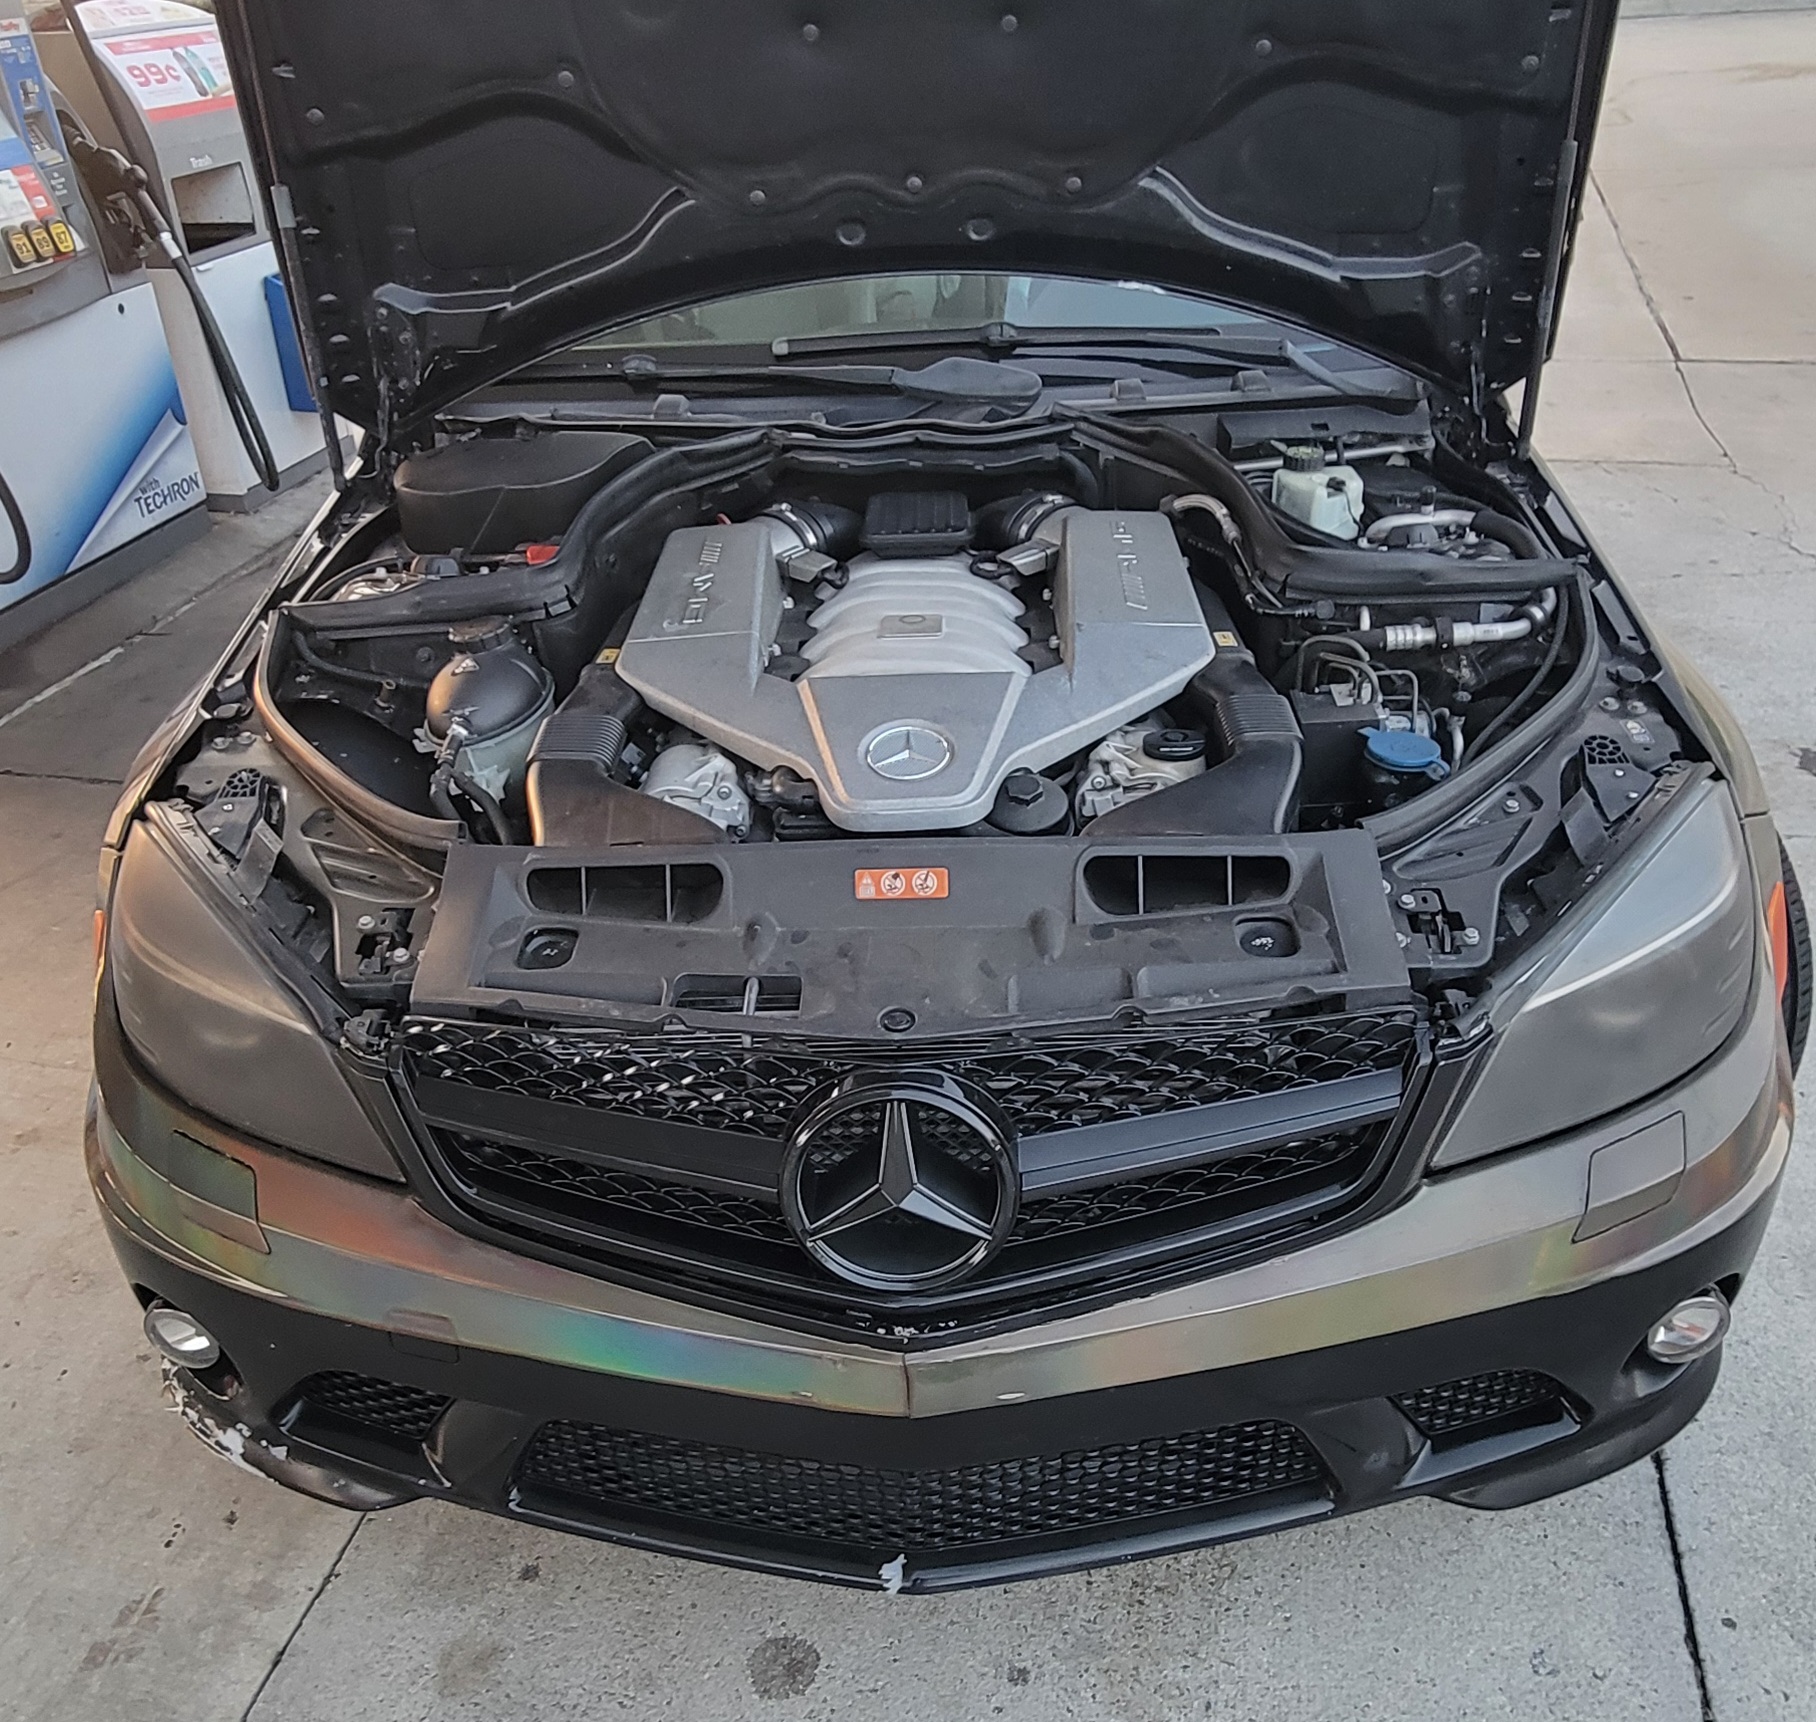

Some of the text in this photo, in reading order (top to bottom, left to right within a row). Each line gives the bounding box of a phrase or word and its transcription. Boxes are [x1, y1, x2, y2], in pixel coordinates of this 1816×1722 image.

[126, 63, 182, 88] 99¢
[36, 236, 51, 250] 89
[55, 230, 69, 245] 87
[16, 242, 32, 254] 91
[138, 477, 161, 495] with
[134, 471, 200, 518] TECHRON
